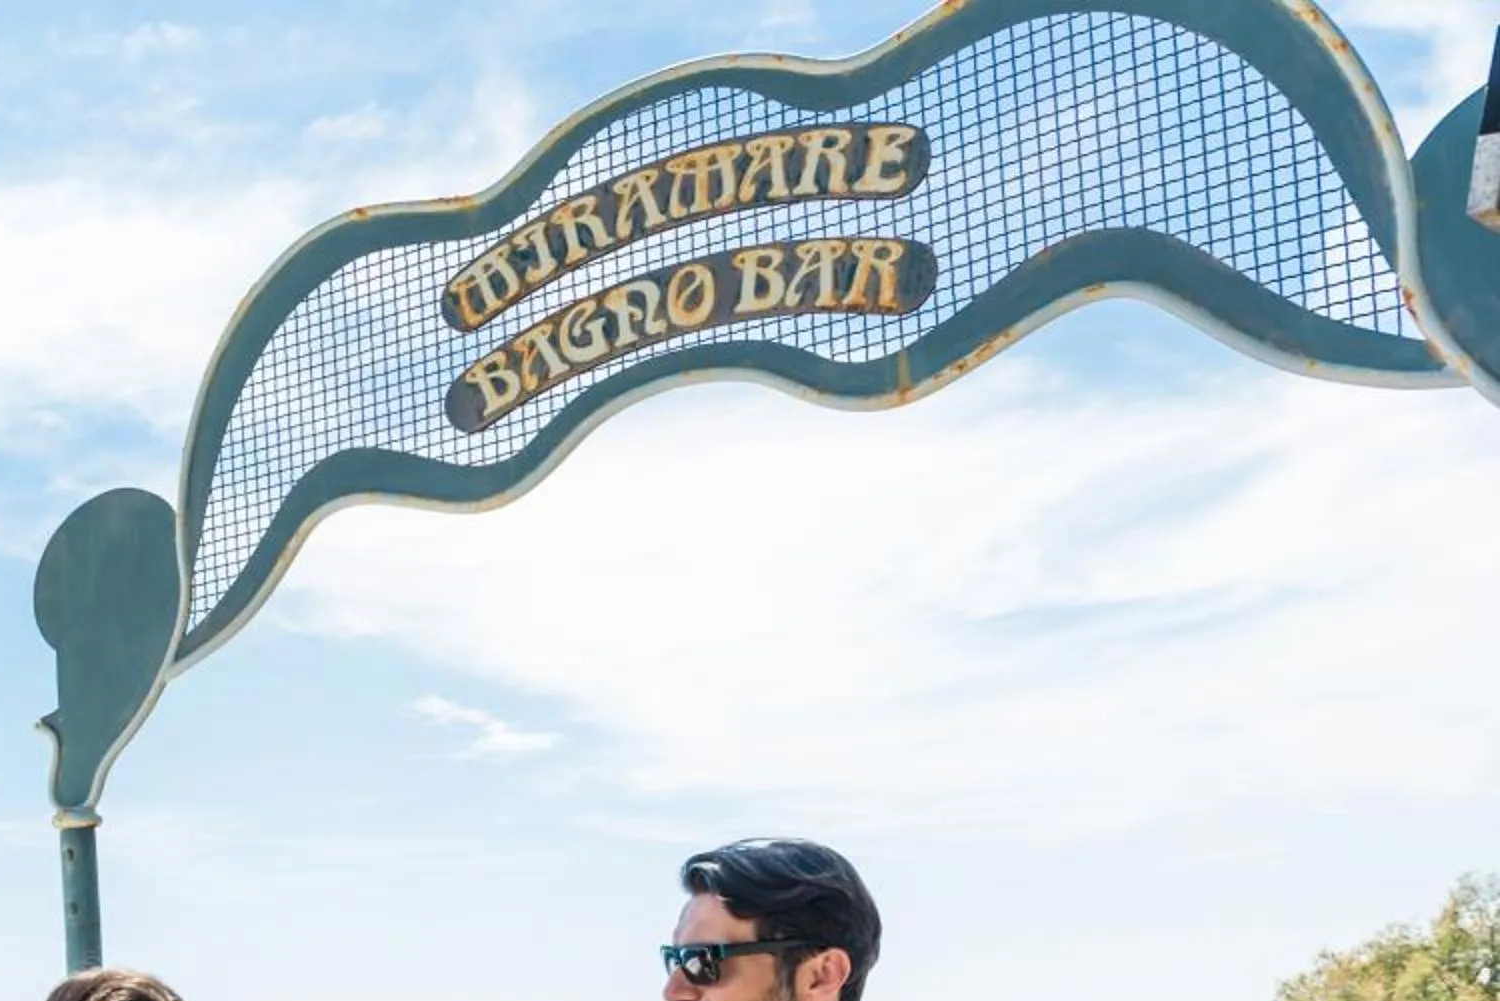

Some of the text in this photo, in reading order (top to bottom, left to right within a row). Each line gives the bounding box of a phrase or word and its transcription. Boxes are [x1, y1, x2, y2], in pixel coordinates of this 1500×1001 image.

[450, 125, 916, 328] MIRAMARE
[466, 237, 906, 418] BAGNO BAR
